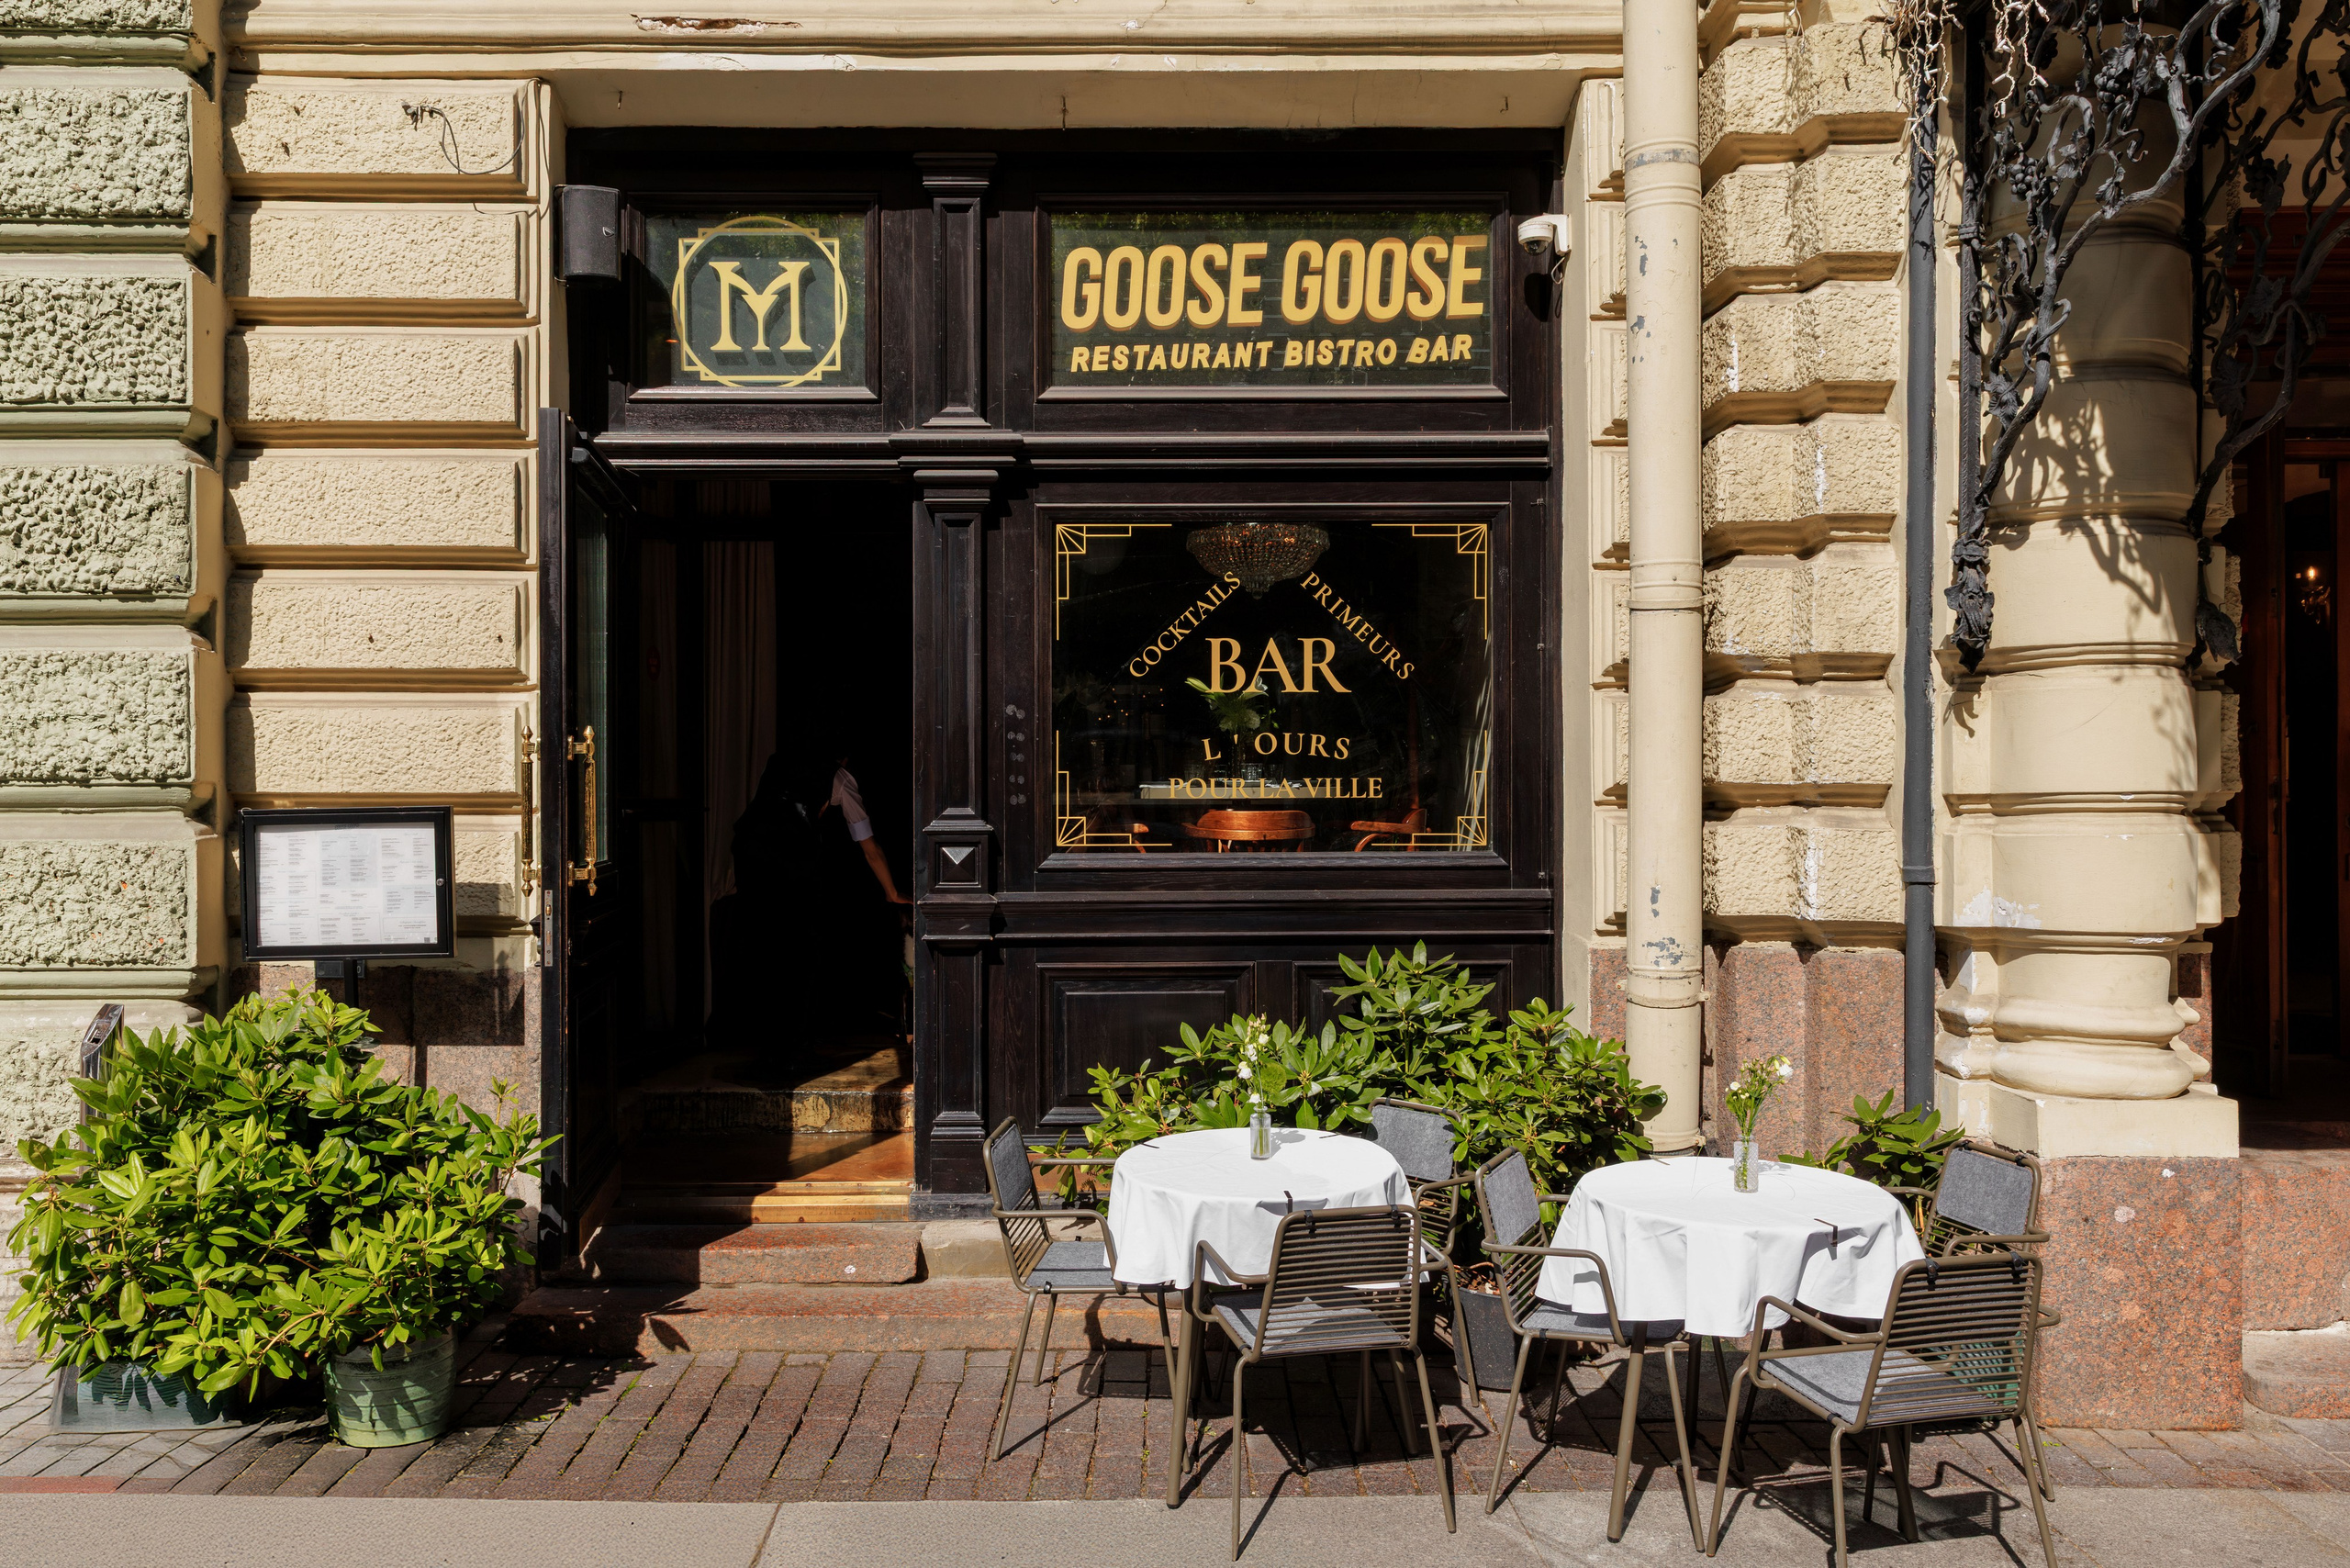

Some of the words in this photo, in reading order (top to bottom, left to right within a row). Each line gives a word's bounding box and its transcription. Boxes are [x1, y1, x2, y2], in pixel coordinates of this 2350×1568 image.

[1059, 241, 1269, 333] GOOSE
[1280, 235, 1488, 326] GOOSE
[1070, 341, 1274, 373] RESTAURANT
[1283, 338, 1398, 367] BISTRO
[1404, 334, 1473, 364] BAR
[1129, 571, 1241, 678] COCKTAILS
[1300, 571, 1415, 681] PRIMEURS
[1205, 637, 1352, 695] BAR
[1168, 778, 1250, 800] POUR
[1259, 778, 1297, 800] LA
[1303, 778, 1383, 800] VILLE
